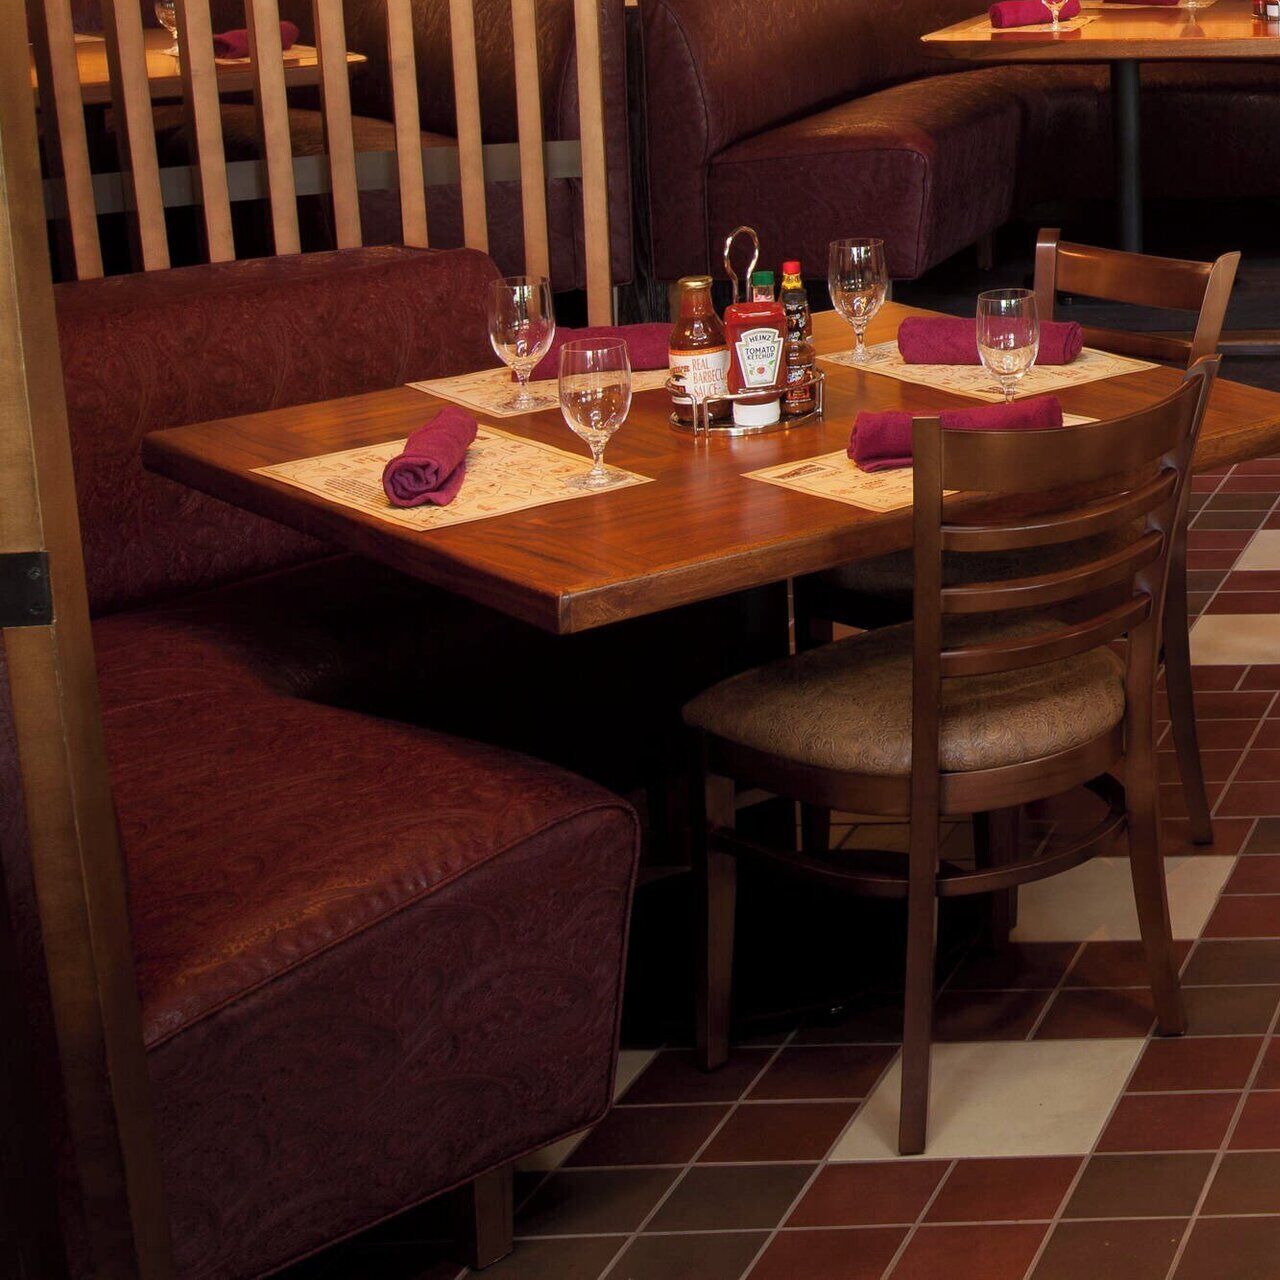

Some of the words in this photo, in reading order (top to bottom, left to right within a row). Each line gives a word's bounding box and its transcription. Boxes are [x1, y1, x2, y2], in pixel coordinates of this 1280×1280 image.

[749, 334, 772, 343] HEINZ
[745, 345, 776, 355] TOMATO
[747, 352, 775, 360] KETCHUP
[692, 358, 709, 371] REAL
[693, 368, 725, 383] BARBECU
[694, 382, 718, 397] SAUCE
